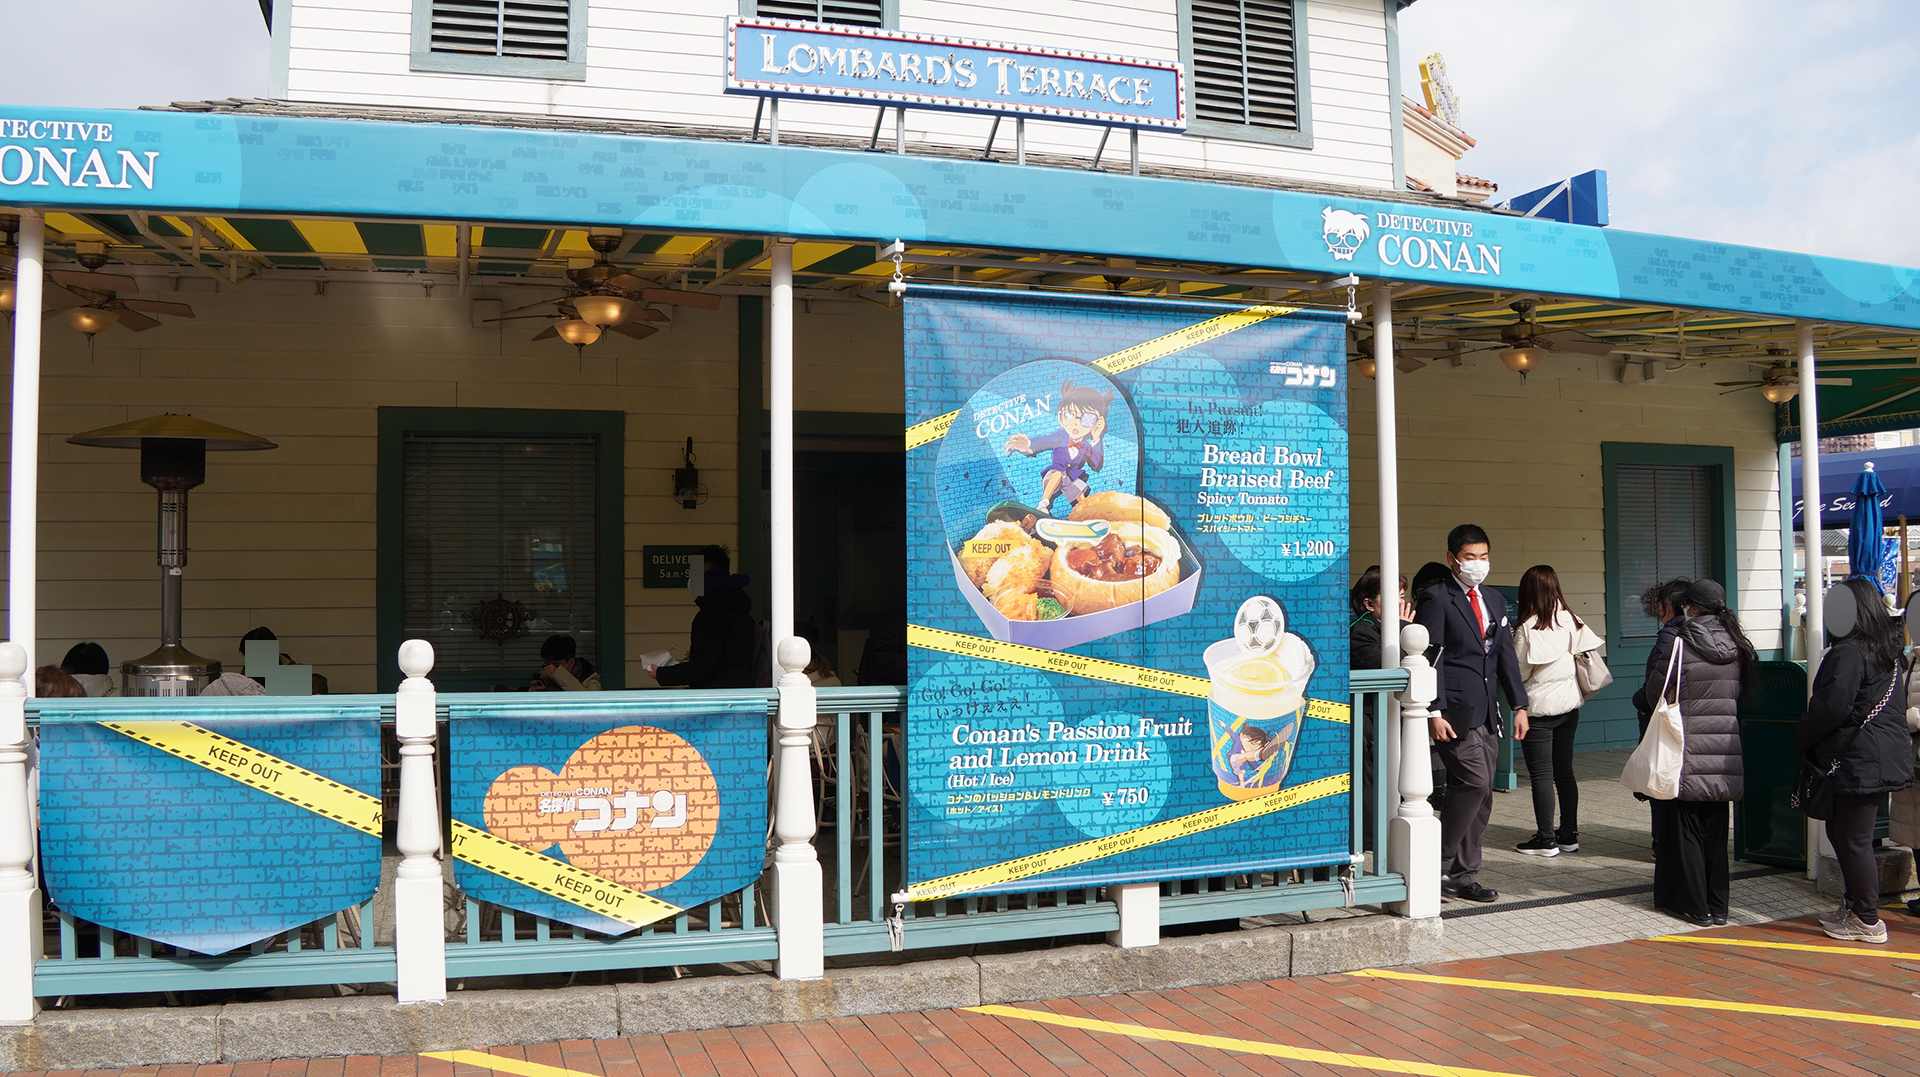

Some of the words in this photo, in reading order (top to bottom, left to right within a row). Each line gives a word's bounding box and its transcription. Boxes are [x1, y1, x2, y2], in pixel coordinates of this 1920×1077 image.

[760, 33, 978, 88] LOMBARD'S
[987, 56, 1155, 106] TERRACE
[1376, 212, 1473, 238] DETECTIVE
[1377, 234, 1502, 276] CONAN
[1185, 329, 1205, 341] KEEP
[1205, 323, 1220, 335] OUT
[1106, 356, 1127, 370] KEEP
[1127, 351, 1143, 362] OUT
[973, 393, 1026, 422] DETECTIVE
[975, 394, 1051, 439] CONAN
[1187, 401, 1203, 415] In
[1208, 402, 1263, 417] Pursuit!
[1201, 444, 1267, 465] Bread
[1272, 445, 1322, 467] Bowl
[1199, 467, 1283, 488] Braised
[1288, 468, 1334, 489] Beef
[1196, 491, 1235, 507] Spicy
[1237, 492, 1289, 505] Tomato
[972, 543, 992, 553] KEEP
[995, 543, 1011, 553] OUT
[1281, 540, 1334, 559] ¥1,200
[652, 555, 690, 565] DELIVE
[955, 640, 977, 651] KEEP
[979, 644, 996, 654] OUT
[1047, 656, 1070, 669] KEEP
[1071, 661, 1088, 671] OUT
[1137, 673, 1158, 684] KEEP
[1158, 676, 1175, 686] OUT
[921, 686, 947, 702] Go!
[950, 681, 977, 698] Go!
[981, 678, 1007, 693] Go!
[1316, 705, 1331, 714] OUT
[951, 723, 1041, 746] Conan's
[1046, 719, 1132, 742] Passion
[1136, 717, 1193, 739] Fruit
[208, 745, 248, 768] KEEP
[251, 762, 283, 783] OUT
[949, 746, 994, 770] and
[999, 746, 1078, 769] Lemon
[1083, 741, 1151, 764] Drink
[947, 774, 979, 789] (Hot
[989, 771, 1015, 787] Ice)
[576, 787, 612, 796] CONAN
[1264, 796, 1283, 808] KEEP
[1283, 792, 1298, 803] OUT
[1182, 818, 1202, 829] KEEP
[1203, 813, 1219, 824] OUT
[1097, 840, 1119, 852] KEEP
[1119, 836, 1136, 847] OUT
[1008, 863, 1030, 874] KEEP
[1030, 858, 1048, 869] OUT
[554, 873, 592, 895] KEEP
[594, 889, 625, 908] OUT
[915, 885, 937, 897] KEEP
[938, 881, 956, 892] OUT
